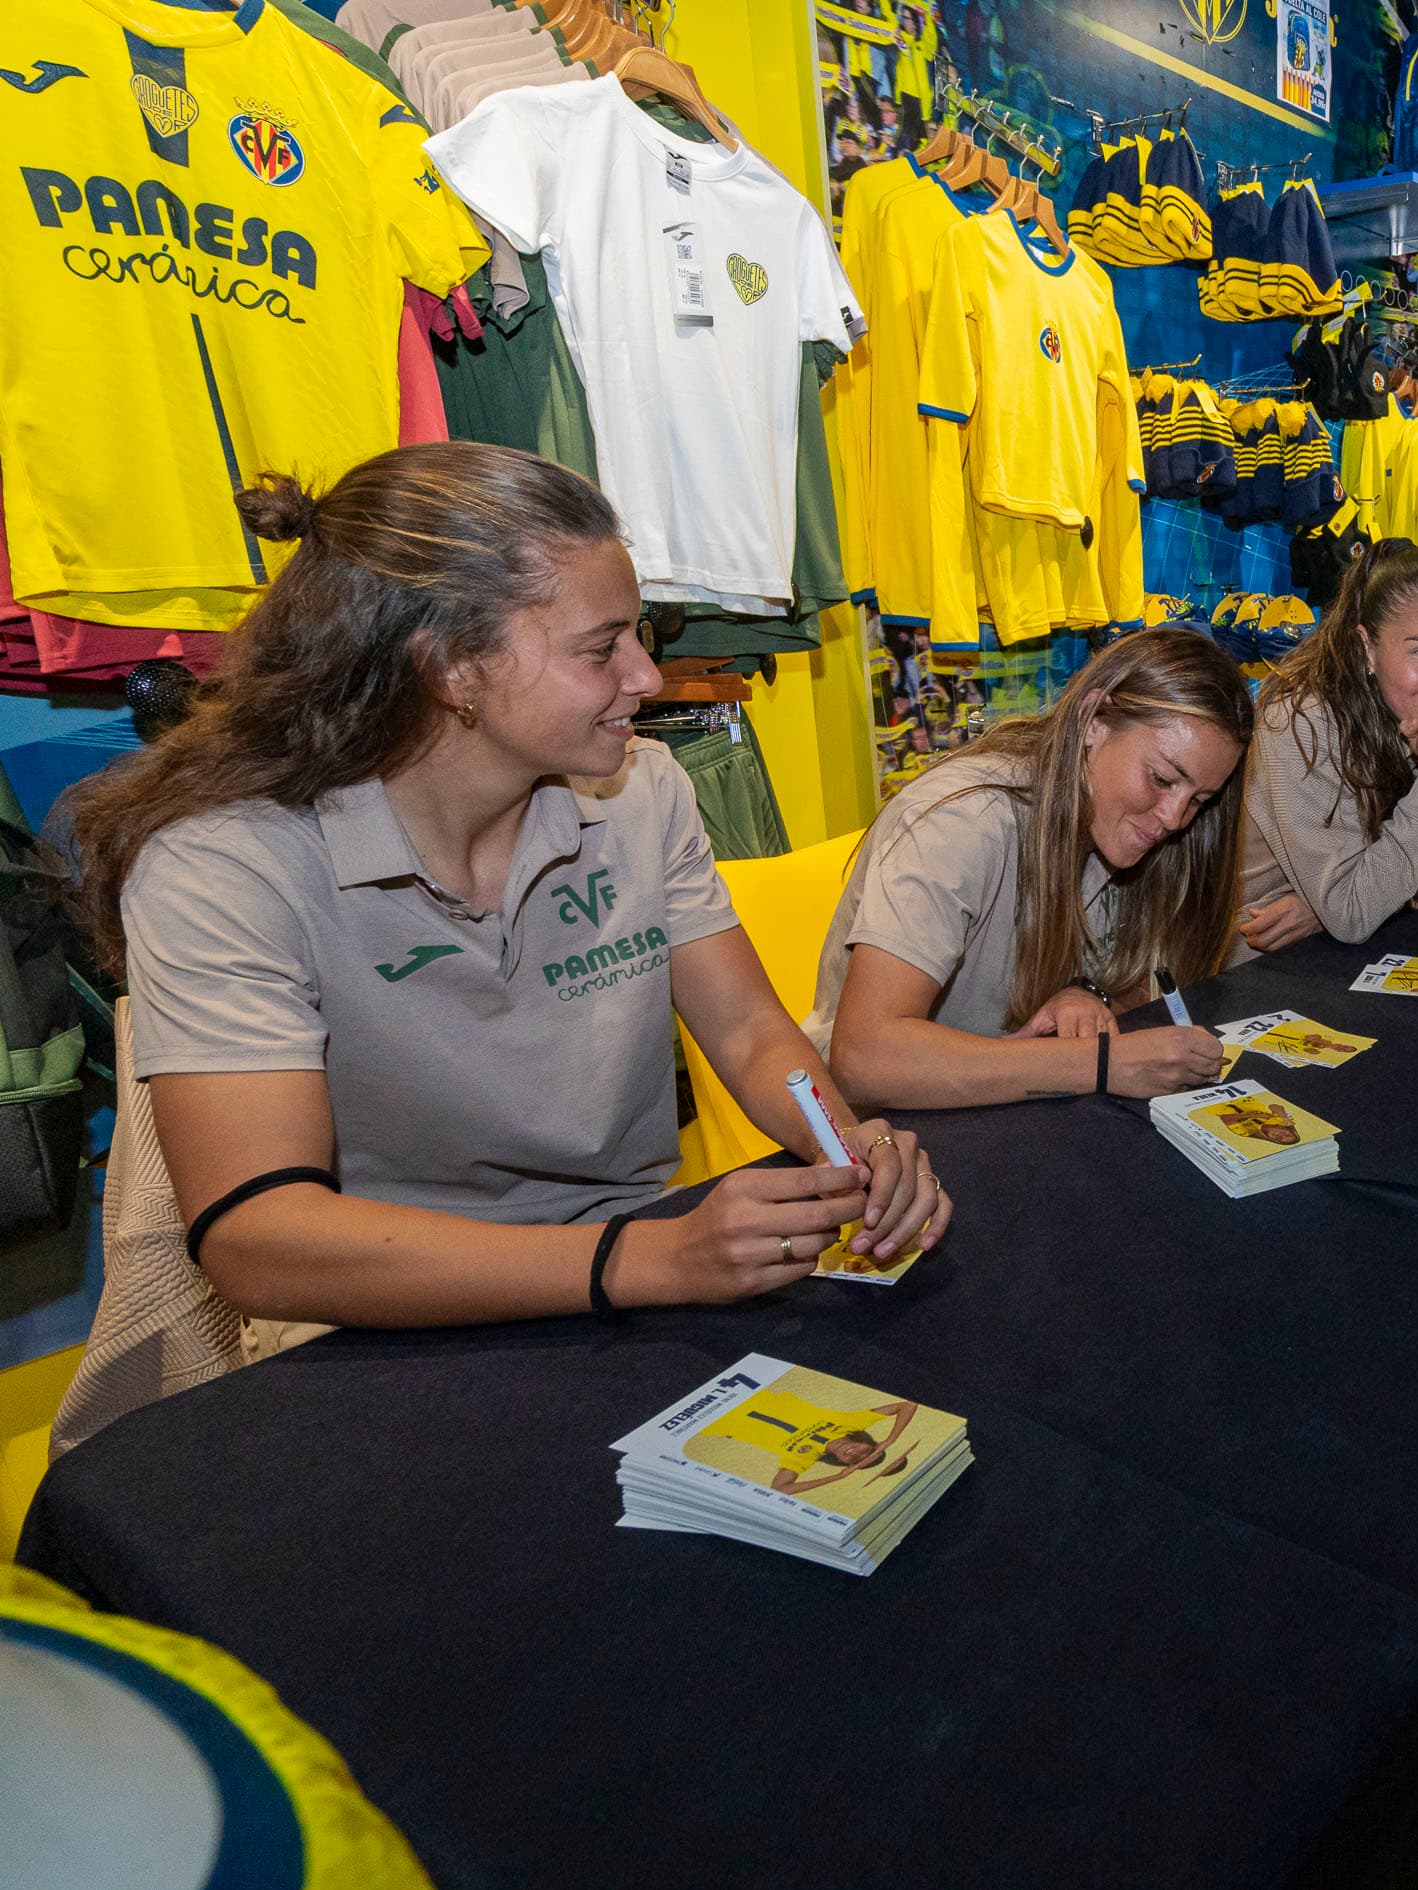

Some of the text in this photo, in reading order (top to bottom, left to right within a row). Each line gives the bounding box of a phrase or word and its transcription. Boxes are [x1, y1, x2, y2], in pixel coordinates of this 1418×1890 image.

[541, 925, 669, 988] PAMESA
[716, 1372, 761, 1390] 4
[657, 1395, 717, 1431] MIGUÉLEZ
